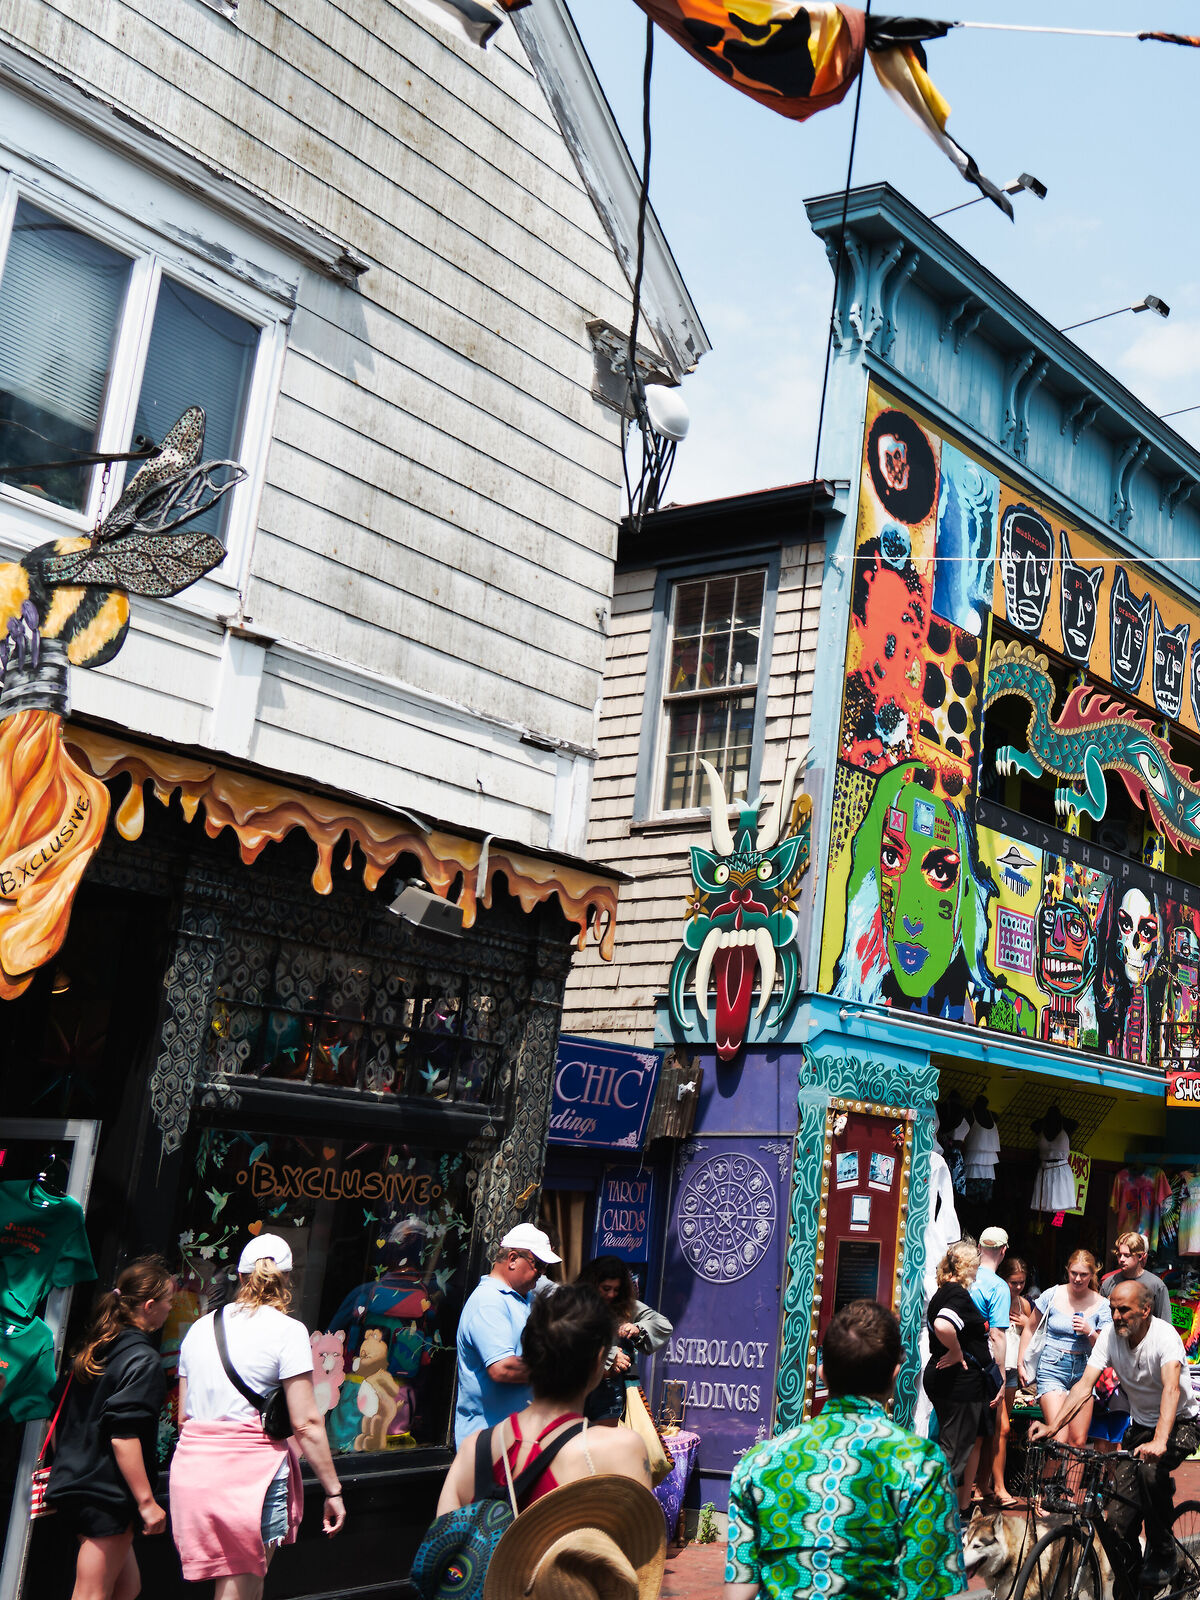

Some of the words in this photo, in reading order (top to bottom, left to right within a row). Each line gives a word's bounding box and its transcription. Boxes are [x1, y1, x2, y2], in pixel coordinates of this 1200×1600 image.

[1015, 526, 1047, 551] mushroom
[1118, 606, 1139, 624] orange
[1166, 641, 1177, 653] cat
[0, 795, 90, 896] B.XCLUSIVE
[1062, 838, 1130, 878] SHOP
[555, 1059, 645, 1110] CHIC
[252, 1161, 432, 1205] B.XCLUSIVE
[608, 1180, 648, 1203] TAROT
[602, 1208, 646, 1232] CARDS
[601, 1231, 643, 1253] Readings
[662, 1336, 769, 1369] ASTROLOGY
[681, 1381, 761, 1413] ADINGS
